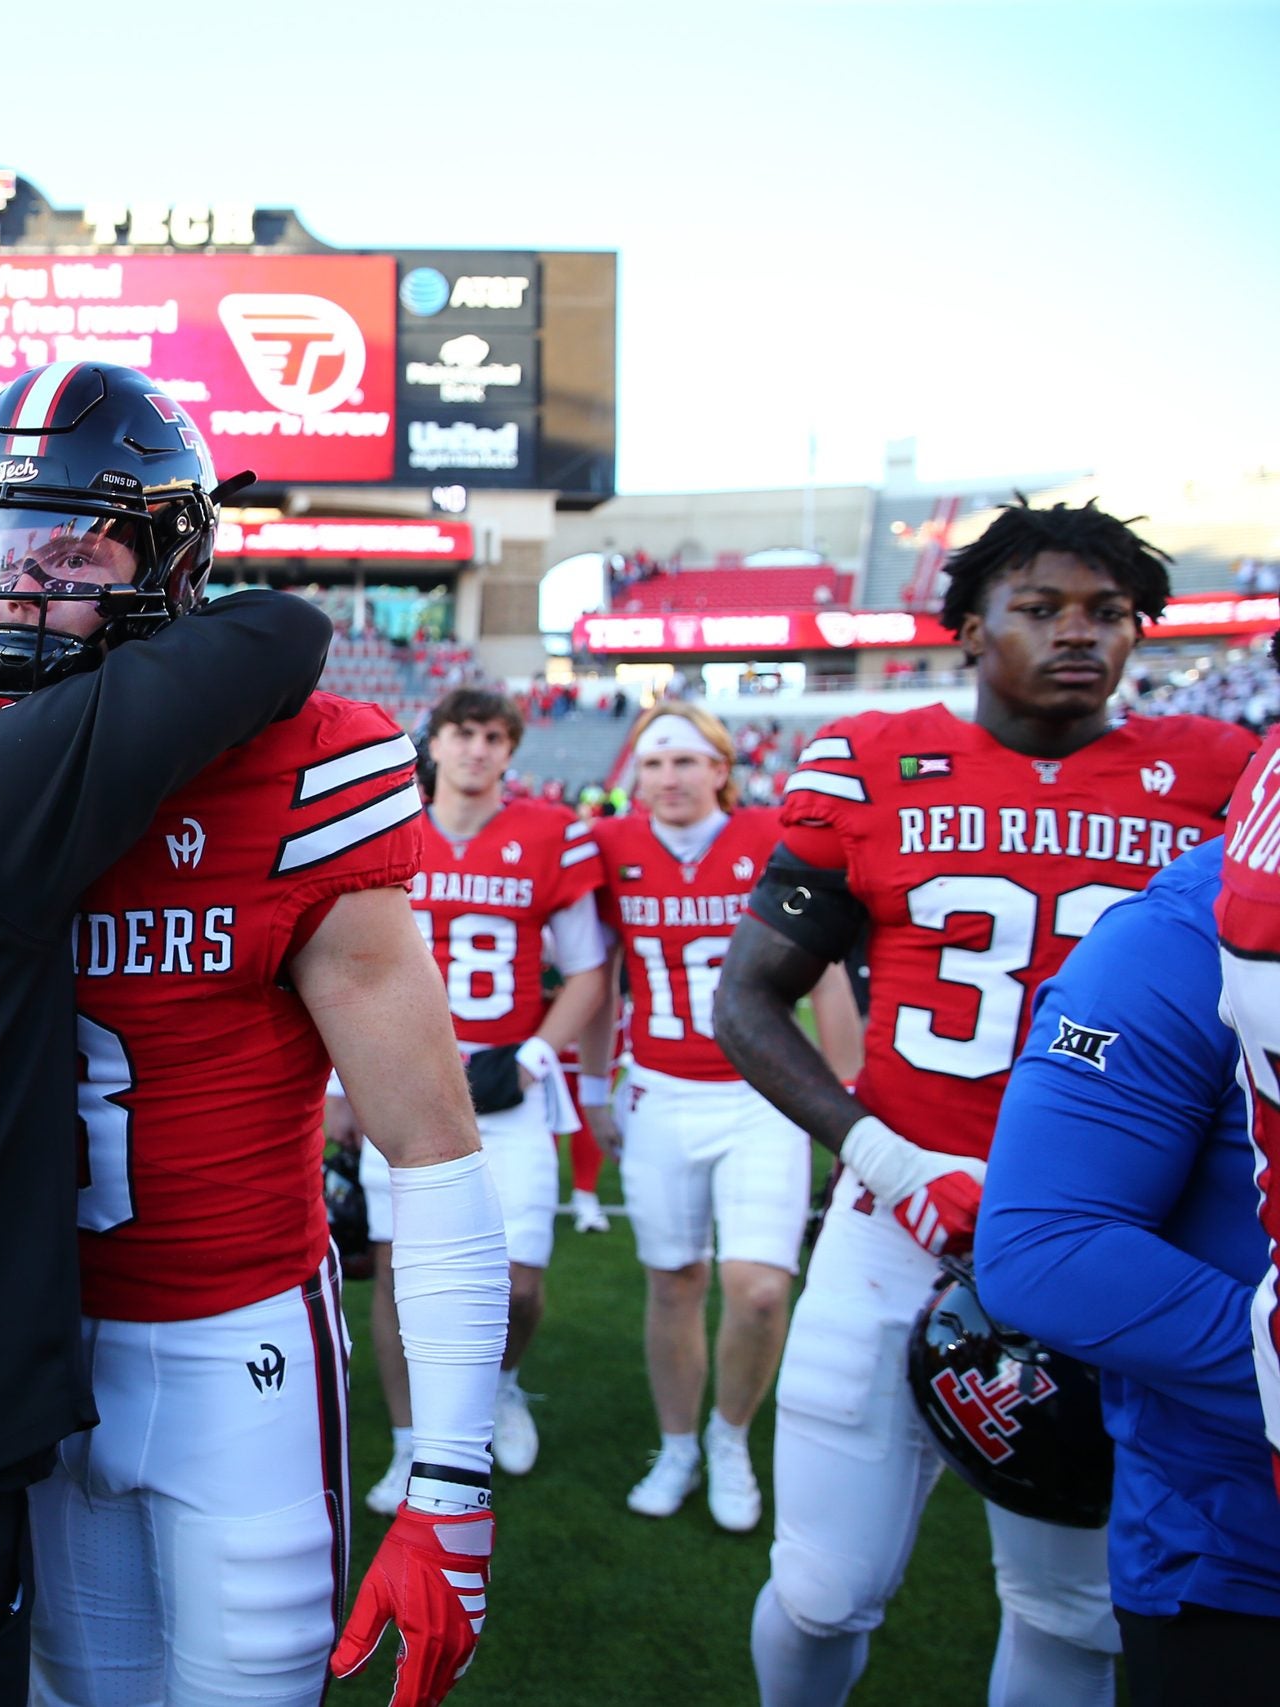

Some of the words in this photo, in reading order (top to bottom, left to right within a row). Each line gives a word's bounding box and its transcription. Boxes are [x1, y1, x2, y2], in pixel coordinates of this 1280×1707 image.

[83, 204, 256, 246] TECH
[0, 457, 38, 482] Tech
[103, 473, 125, 486] GUNS
[126, 479, 138, 488] UP
[899, 805, 985, 854] RED
[431, 872, 533, 908] RAIDERS
[663, 893, 751, 926] RAIDE
[894, 876, 1136, 1079] 3
